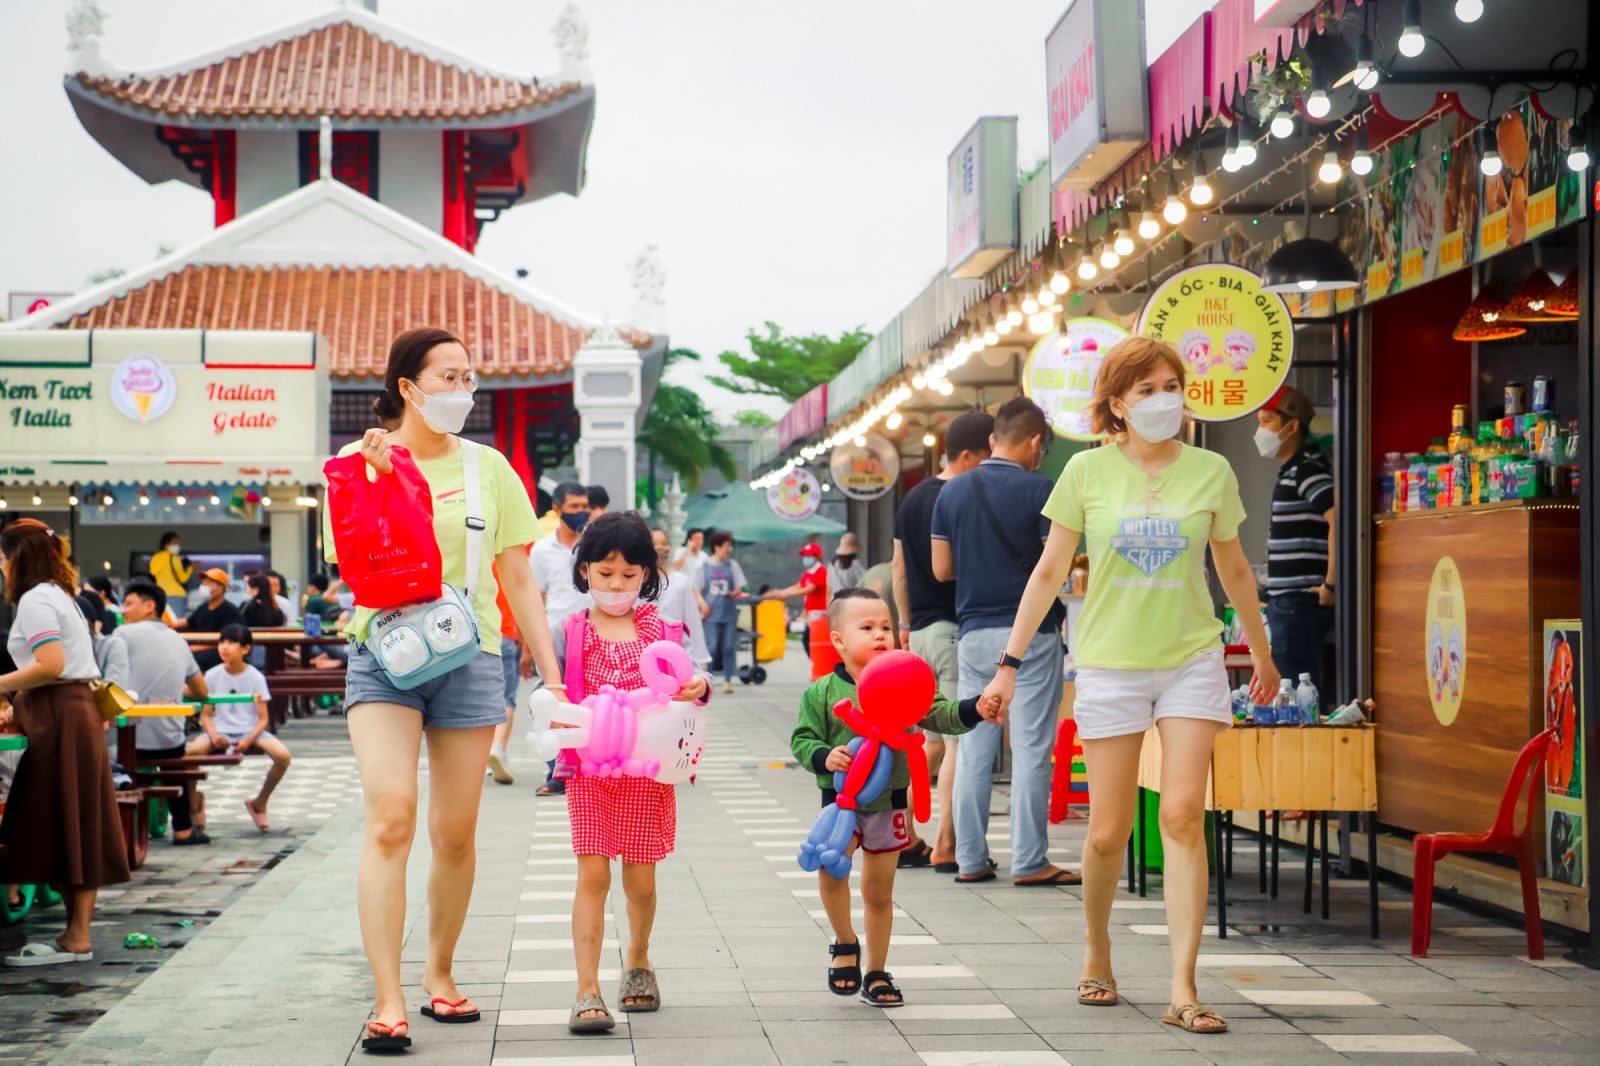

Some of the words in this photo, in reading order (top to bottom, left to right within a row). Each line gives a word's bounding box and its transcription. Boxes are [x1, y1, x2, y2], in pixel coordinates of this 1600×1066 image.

[1180, 278, 1204, 296] ỐC
[1219, 276, 1243, 293] BIA
[1167, 297, 1179, 308] &
[1255, 295, 1280, 326] GIẢI
[1197, 312, 1234, 328] HOUSE
[1267, 331, 1284, 373] KHÁT
[206, 383, 276, 401] Italian
[11, 406, 72, 427] Italia
[213, 411, 277, 435] Gelato
[376, 610, 402, 629] RUBYS
